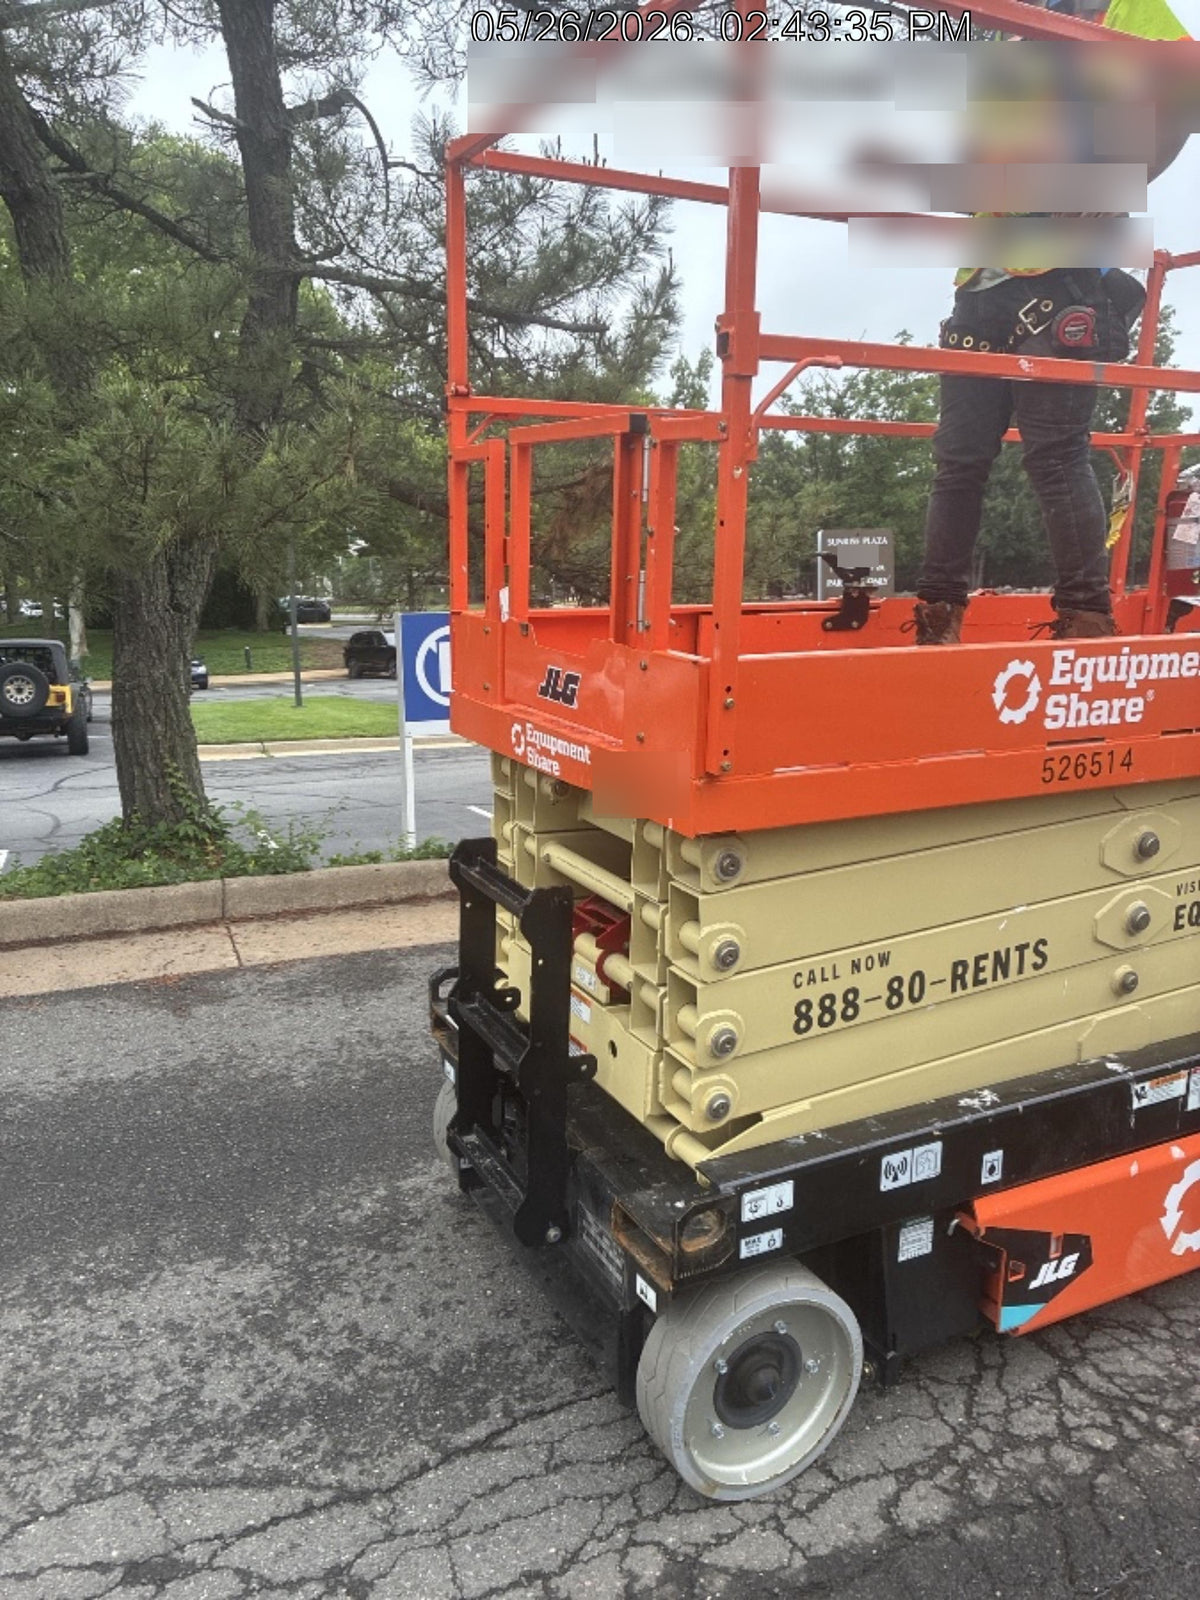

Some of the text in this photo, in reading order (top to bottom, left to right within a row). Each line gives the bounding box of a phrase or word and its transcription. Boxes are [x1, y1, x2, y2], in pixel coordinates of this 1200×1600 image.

[537, 664, 582, 709] JLG
[1049, 647, 1200, 691] Equipme
[525, 722, 592, 766] Equipment
[526, 745, 560, 776] Share
[1041, 748, 1133, 783] 526514
[792, 938, 1049, 1036] 888-80-RENTS
[793, 951, 891, 989] CALL NOW
[1028, 1252, 1080, 1290] JLG
